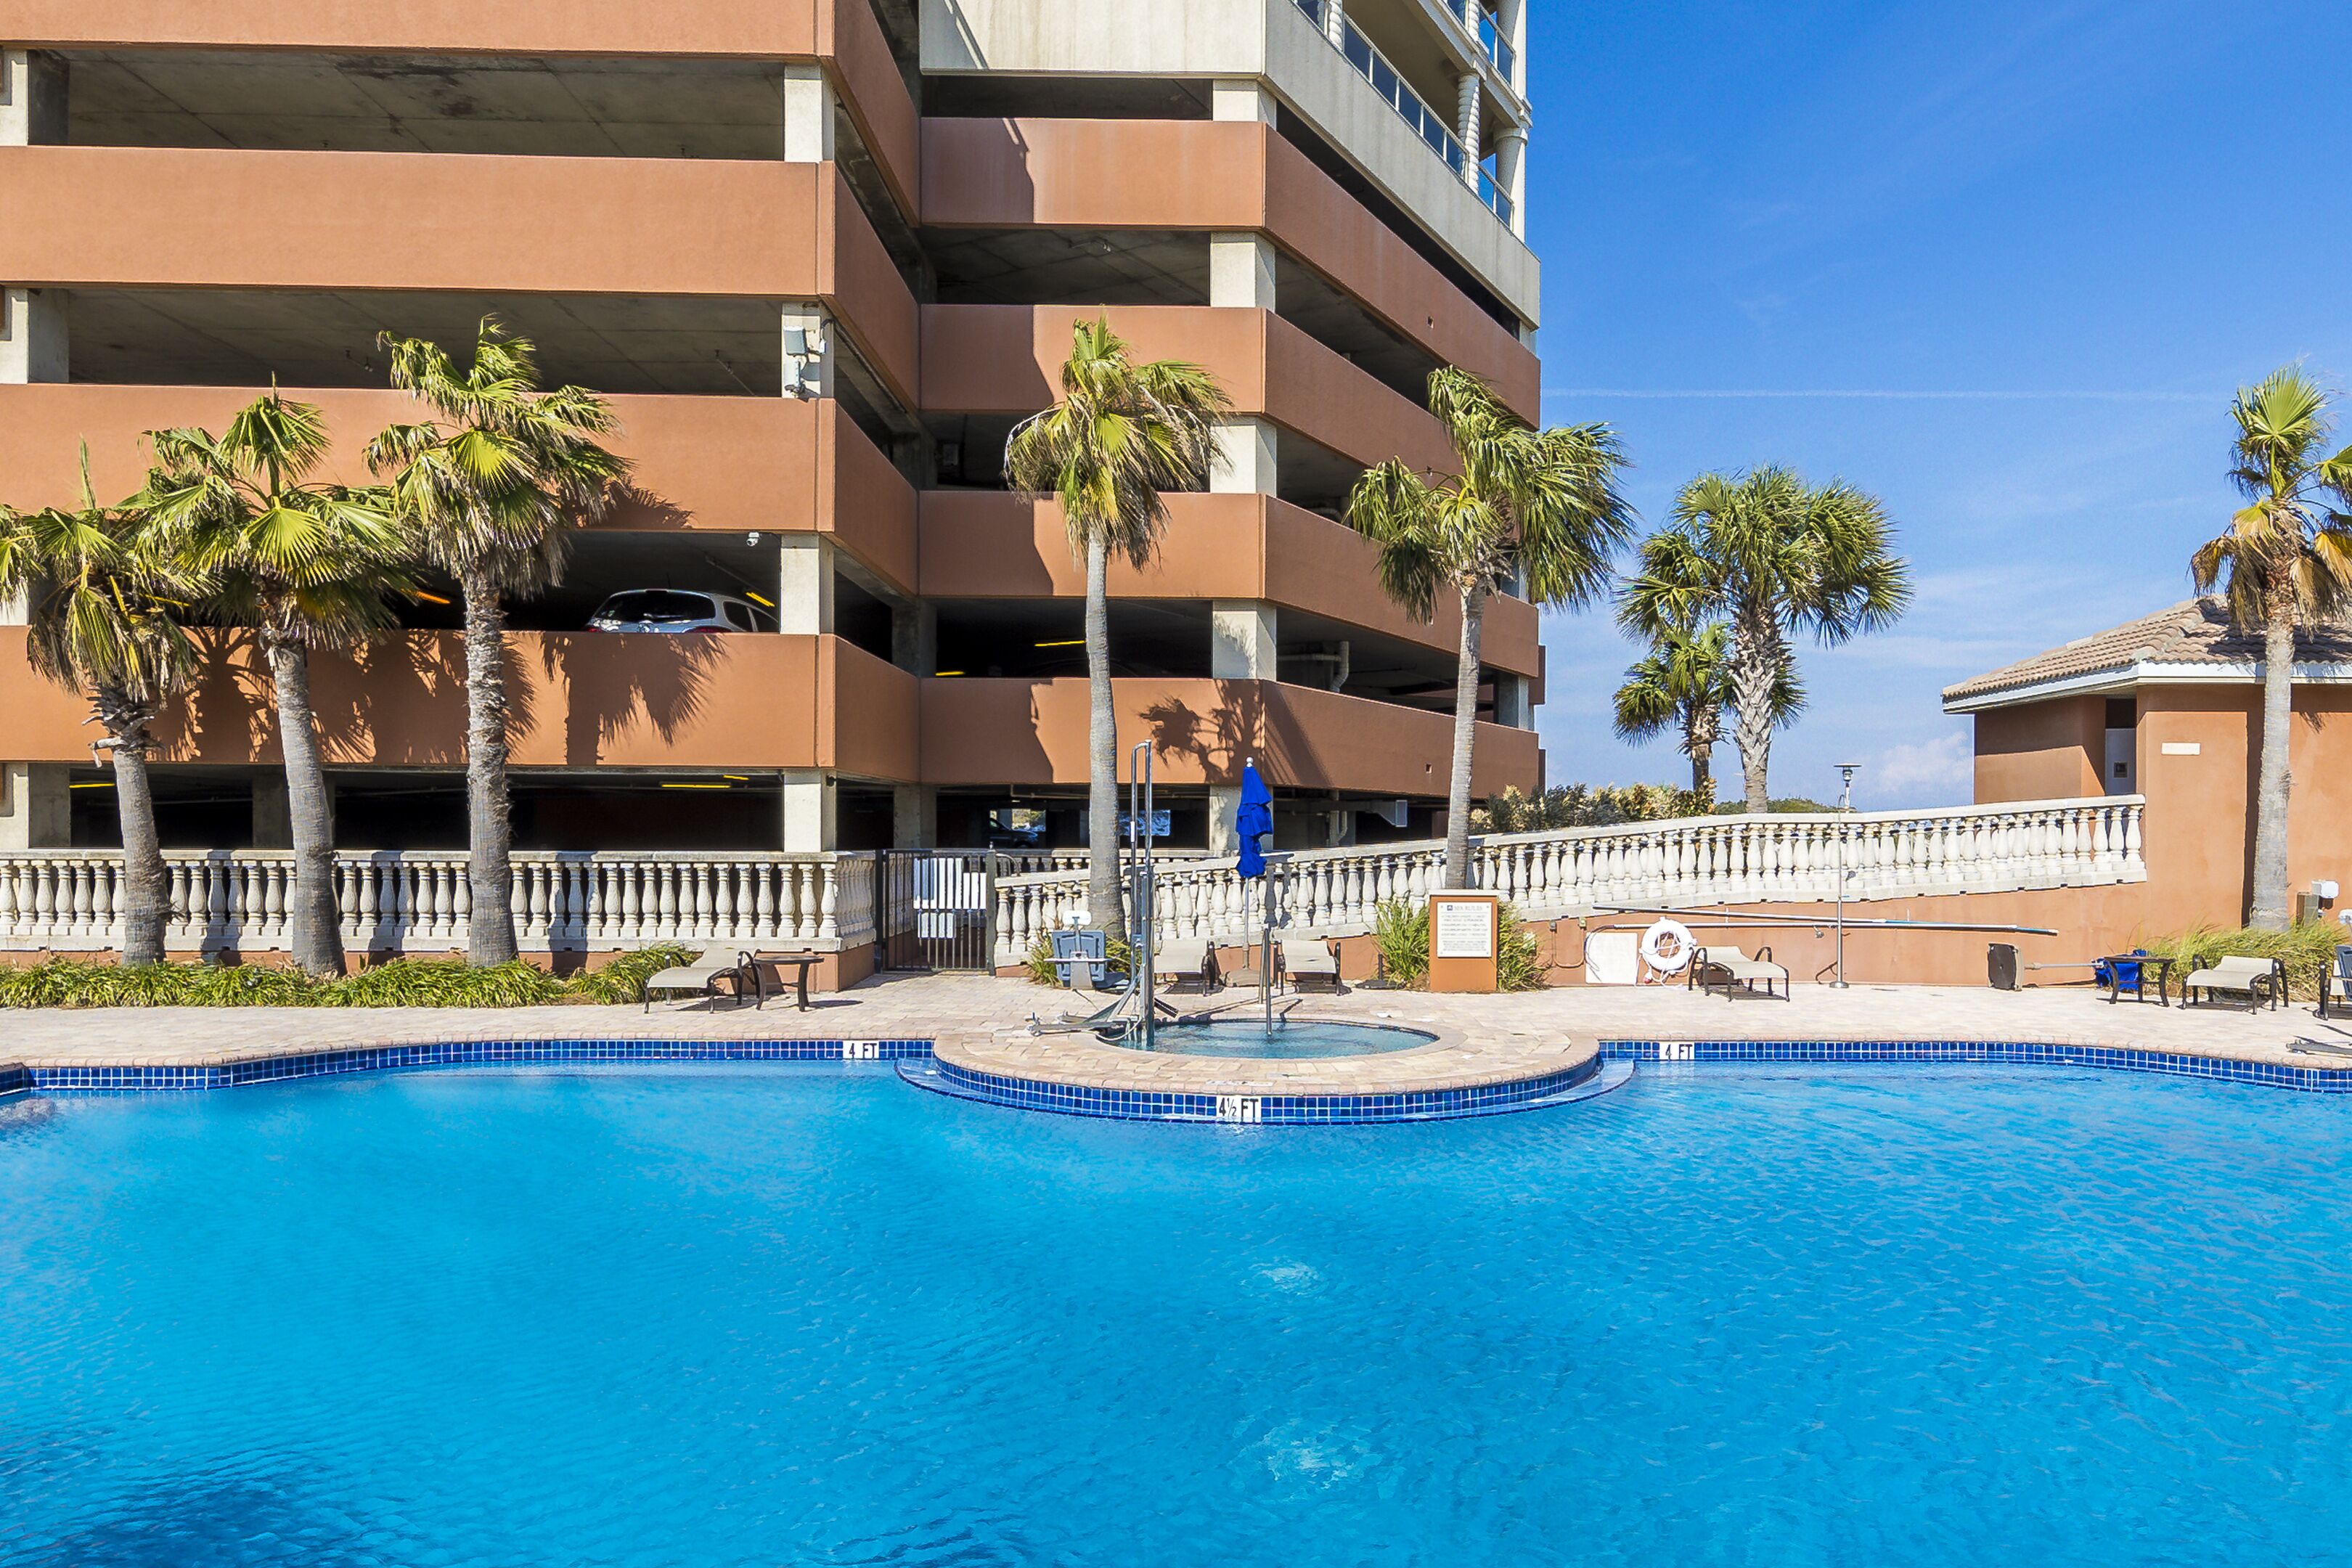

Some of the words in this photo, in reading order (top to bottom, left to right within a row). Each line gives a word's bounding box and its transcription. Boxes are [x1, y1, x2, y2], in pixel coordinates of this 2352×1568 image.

[849, 1042, 855, 1059] 4
[862, 1042, 877, 1059] FT
[1665, 1043, 1672, 1061] 4
[1679, 1043, 1693, 1061] FT
[1241, 1098, 1259, 1122] FT
